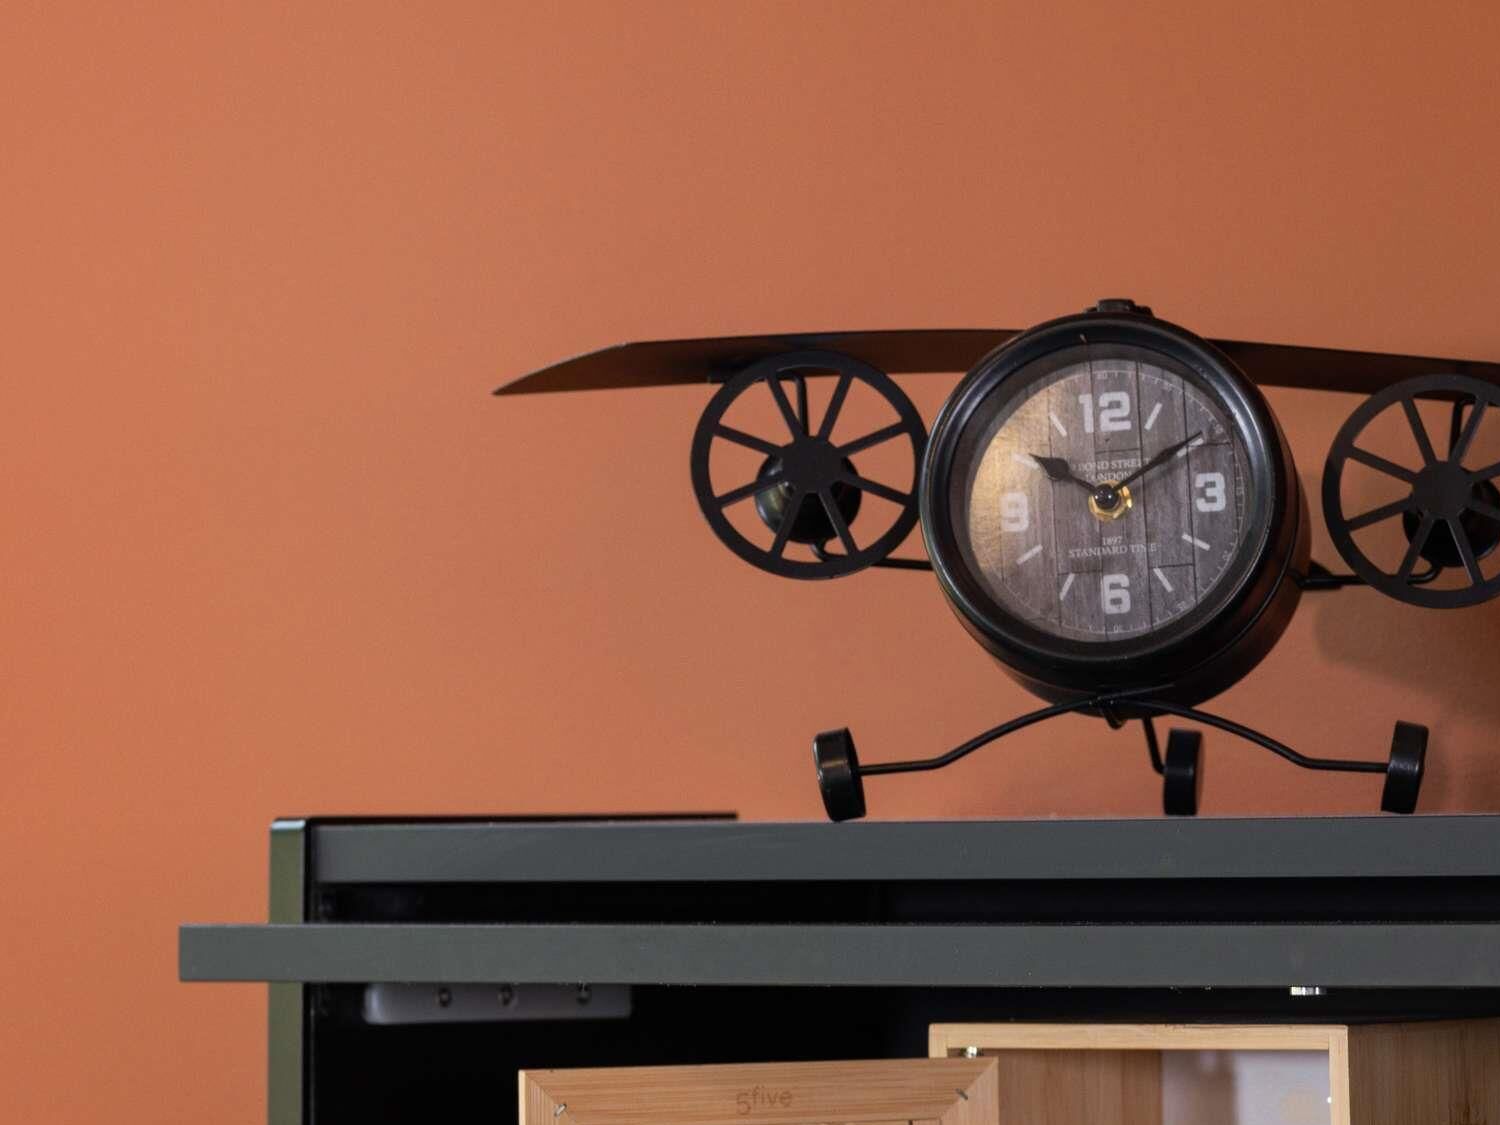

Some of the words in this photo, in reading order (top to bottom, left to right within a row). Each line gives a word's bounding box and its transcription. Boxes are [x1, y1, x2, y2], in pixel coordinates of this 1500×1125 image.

[1079, 391, 1132, 433] 12
[1001, 492, 1029, 532] 9
[1195, 472, 1226, 512] 3
[1068, 545, 1128, 558] STANDARD
[1102, 574, 1131, 614] 6
